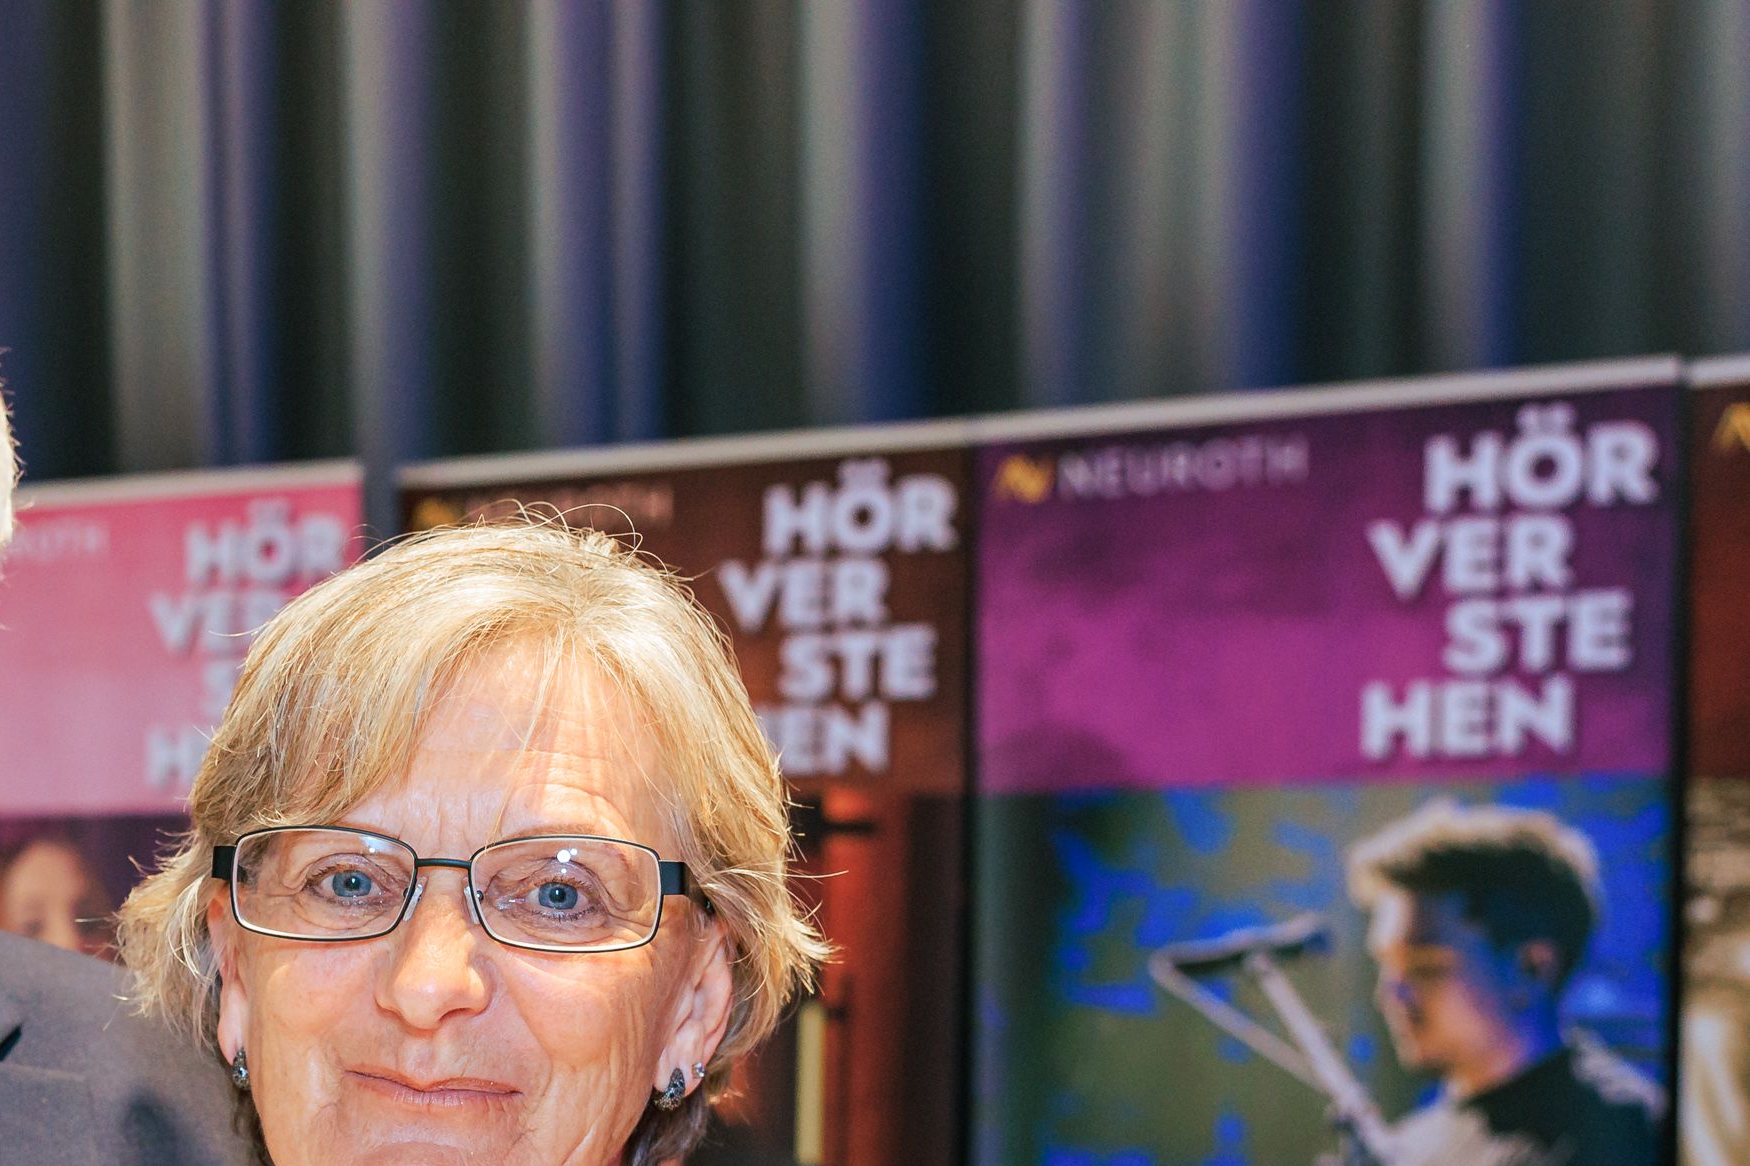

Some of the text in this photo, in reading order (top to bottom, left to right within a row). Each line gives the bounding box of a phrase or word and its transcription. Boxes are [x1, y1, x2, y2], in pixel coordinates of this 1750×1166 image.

[1059, 434, 1310, 498] NEUROTH
[1424, 402, 1656, 512] HÖR
[185, 500, 347, 585] HÖR
[763, 459, 956, 554] HÖR
[716, 558, 891, 633] VER
[1368, 512, 1574, 600] VER
[779, 623, 936, 700] STE
[1442, 590, 1632, 674] STE
[1359, 676, 1575, 761] HEN
